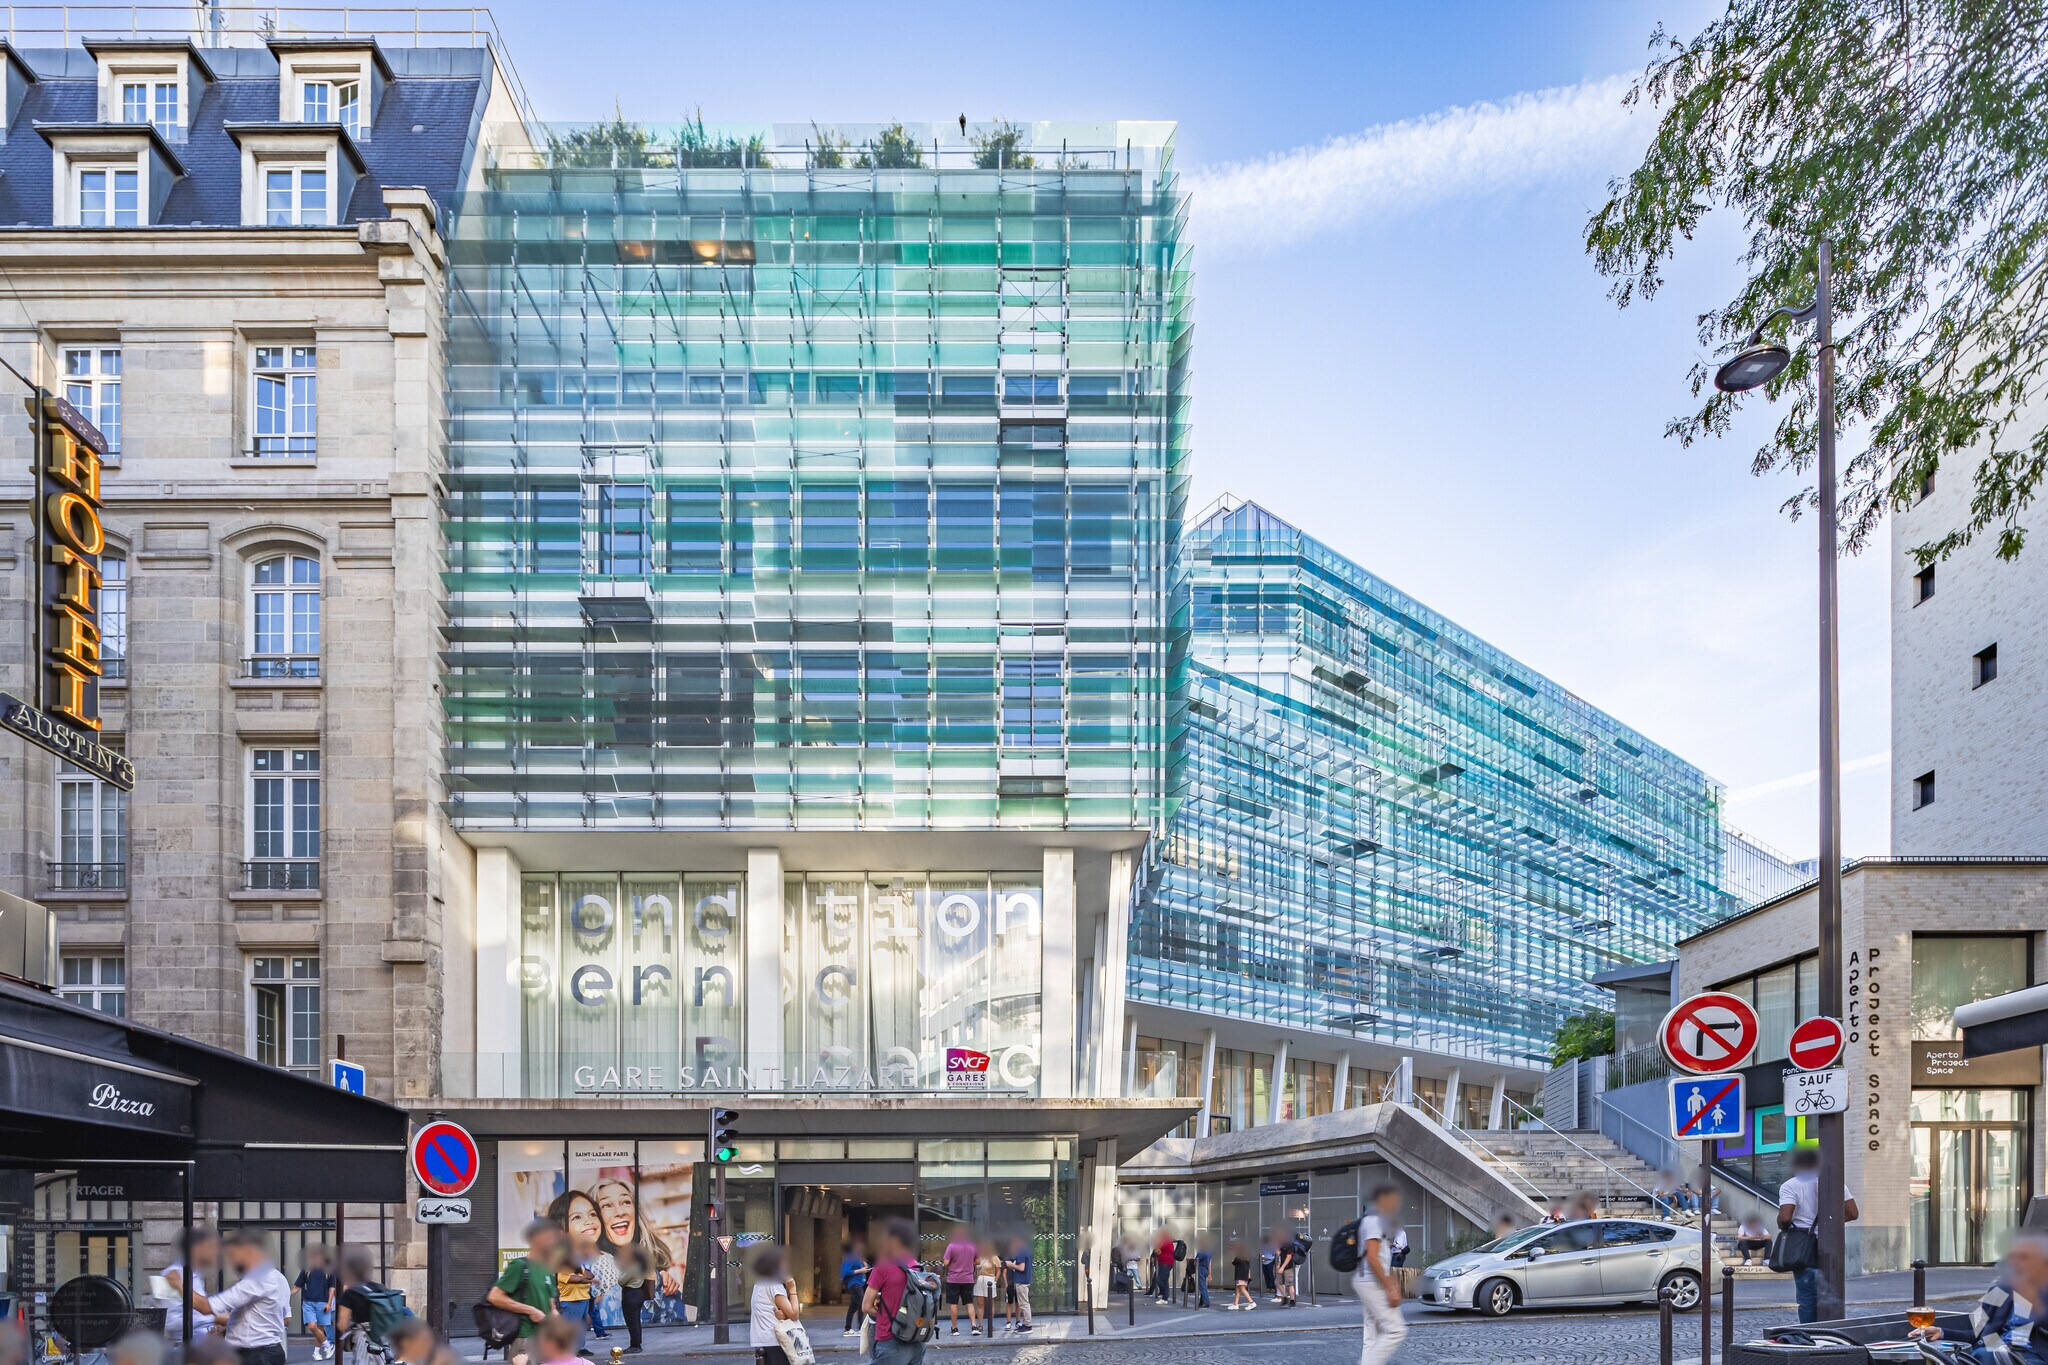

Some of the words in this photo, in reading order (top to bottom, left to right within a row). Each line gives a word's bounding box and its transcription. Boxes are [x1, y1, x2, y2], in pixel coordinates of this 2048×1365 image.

[49, 424, 104, 731] HOTEL
[12, 705, 136, 784] AUSTIN'S
[1849, 951, 1859, 1043] Aperto
[1869, 948, 1880, 1057] Project
[948, 1057, 987, 1068] SNCF
[1926, 1051, 1959, 1060] Aperto
[574, 1066, 663, 1088] GARE
[681, 1066, 915, 1088] SAINT-LAZARE
[947, 1074, 985, 1082] GARES
[1799, 1073, 1833, 1086] SAUF
[88, 1083, 155, 1117] Pizza
[1869, 1074, 1880, 1151] Space
